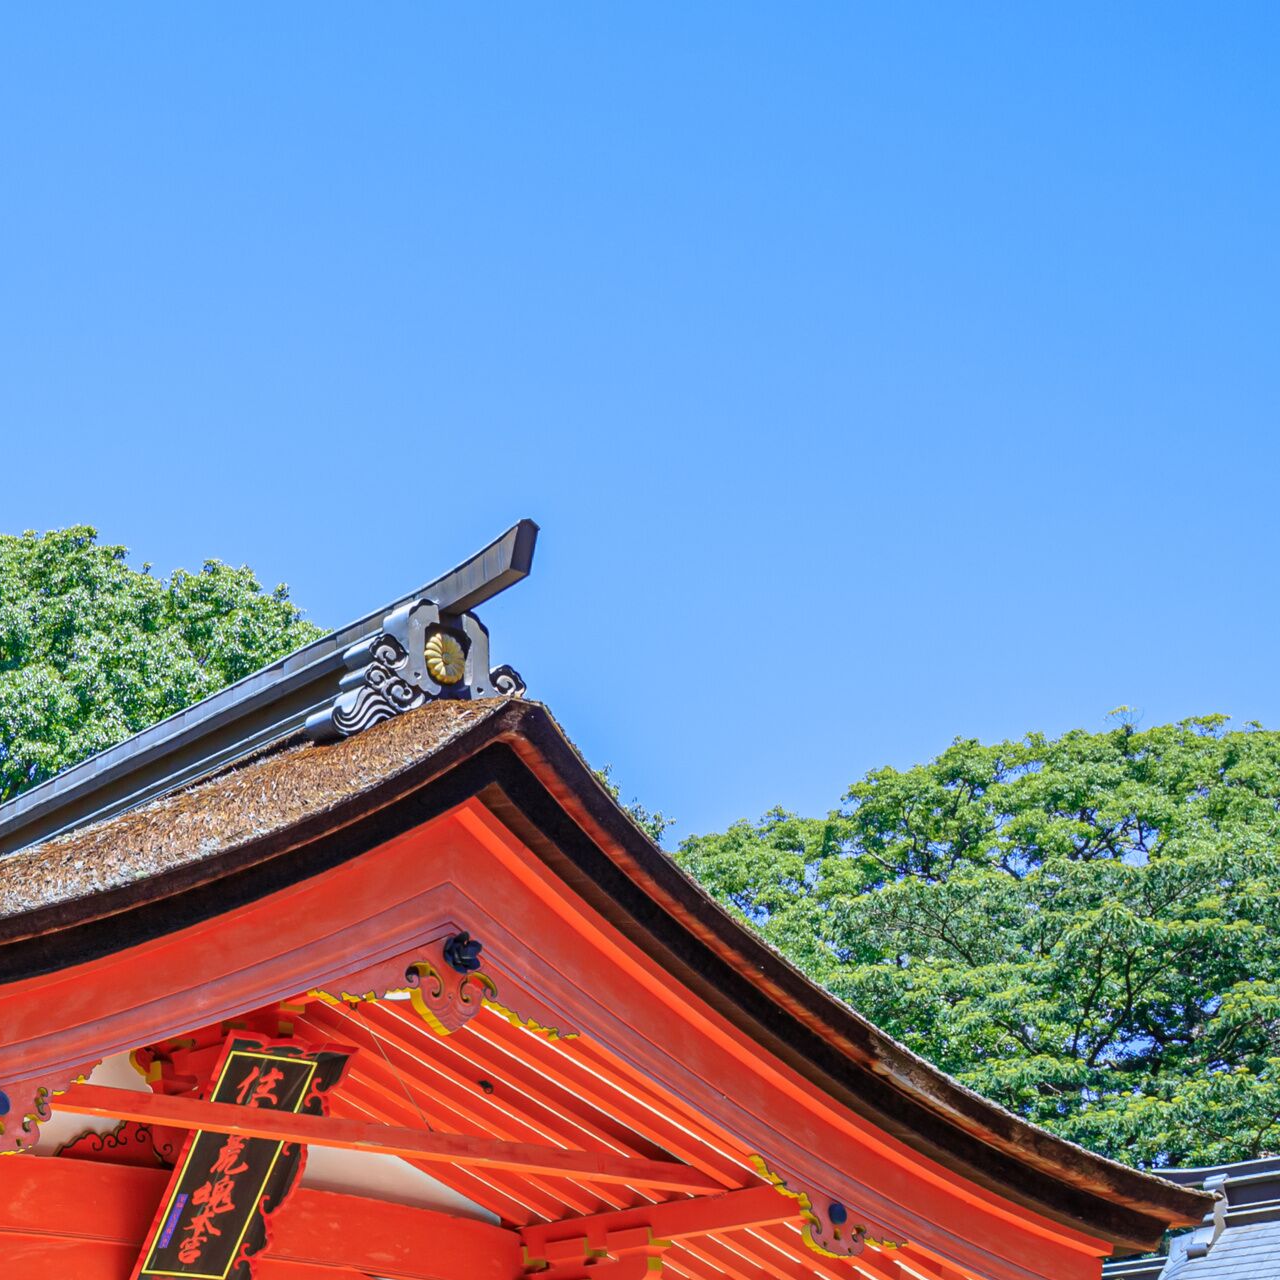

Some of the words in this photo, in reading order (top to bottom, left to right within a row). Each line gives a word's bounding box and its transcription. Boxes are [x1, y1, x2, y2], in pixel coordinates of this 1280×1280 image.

[178, 1066, 284, 1264] 住荒魂本宮
